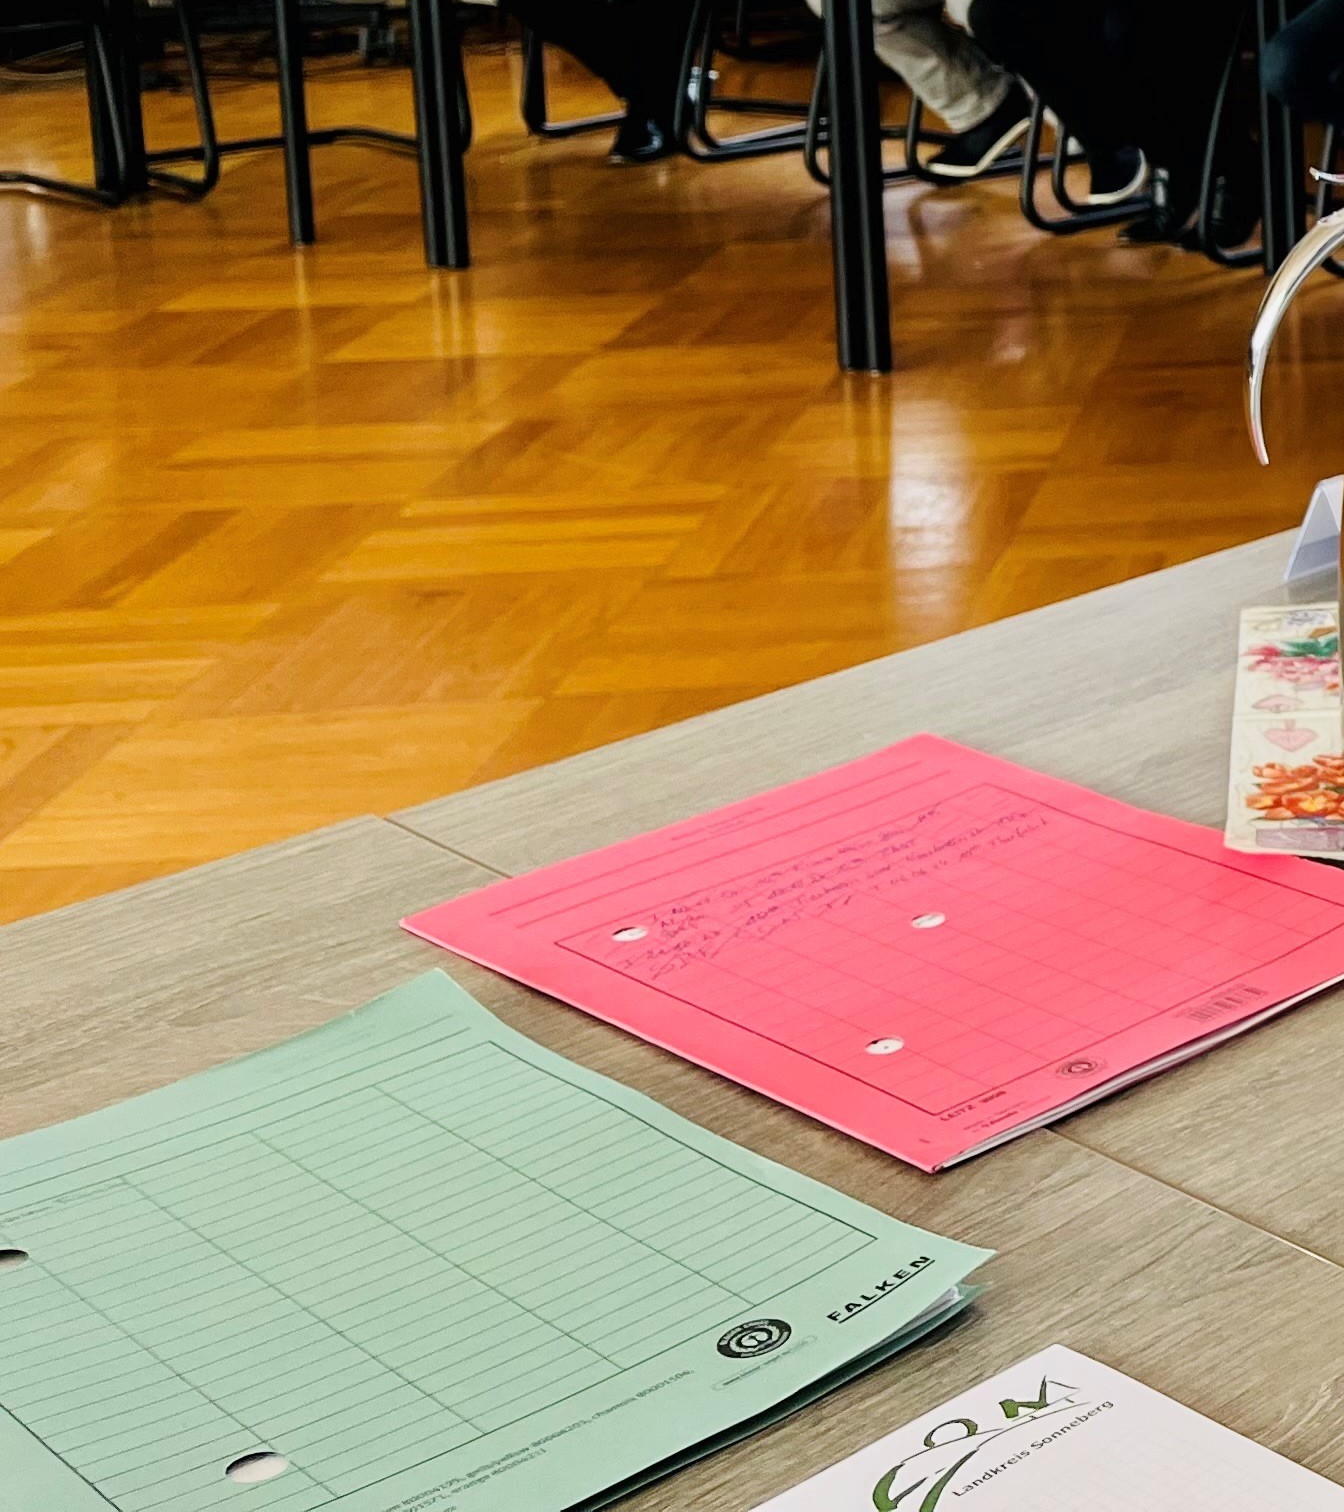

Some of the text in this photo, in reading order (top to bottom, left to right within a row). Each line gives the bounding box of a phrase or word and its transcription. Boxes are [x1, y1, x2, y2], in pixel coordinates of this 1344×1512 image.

[826, 1255, 931, 1322] FALKEN
[951, 1399, 1115, 1497] Landkreis Sonneberg
